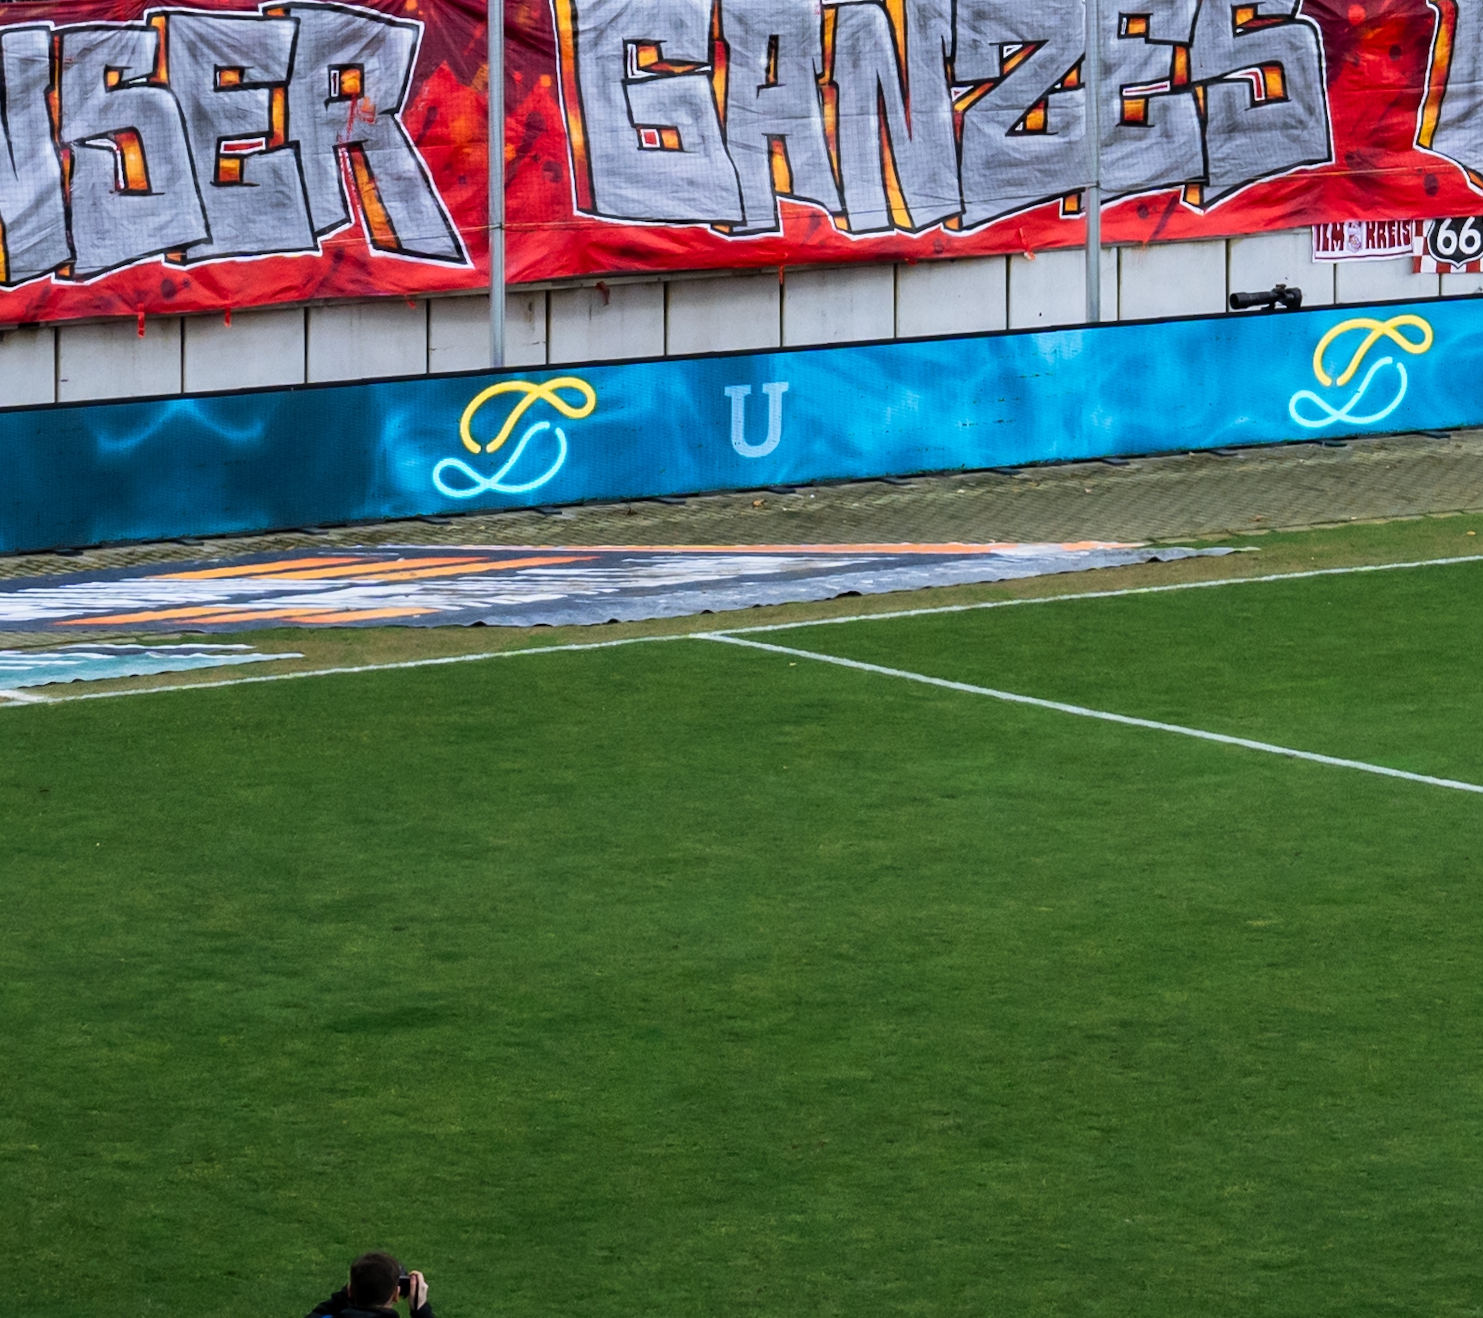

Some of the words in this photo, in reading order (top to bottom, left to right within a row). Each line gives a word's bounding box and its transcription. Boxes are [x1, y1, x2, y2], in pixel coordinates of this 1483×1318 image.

[1366, 219, 1412, 250] KREIS
[1435, 217, 1482, 257] 66
[723, 380, 790, 459] U
